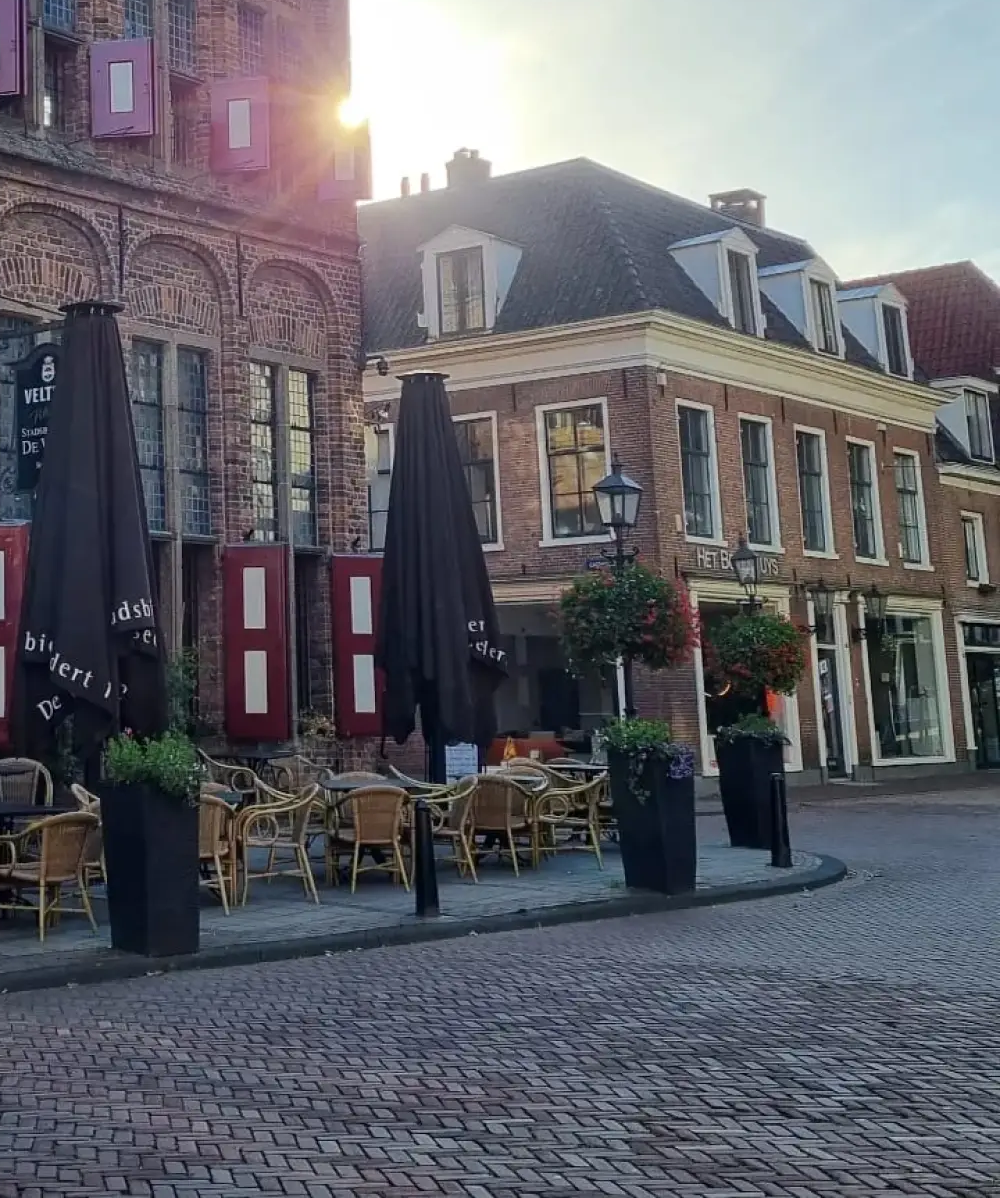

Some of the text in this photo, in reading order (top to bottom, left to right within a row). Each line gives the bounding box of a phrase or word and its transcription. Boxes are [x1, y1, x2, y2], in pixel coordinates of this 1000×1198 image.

[24, 385, 56, 404] VELT
[697, 546, 718, 570] HET
[36, 695, 62, 720] De
